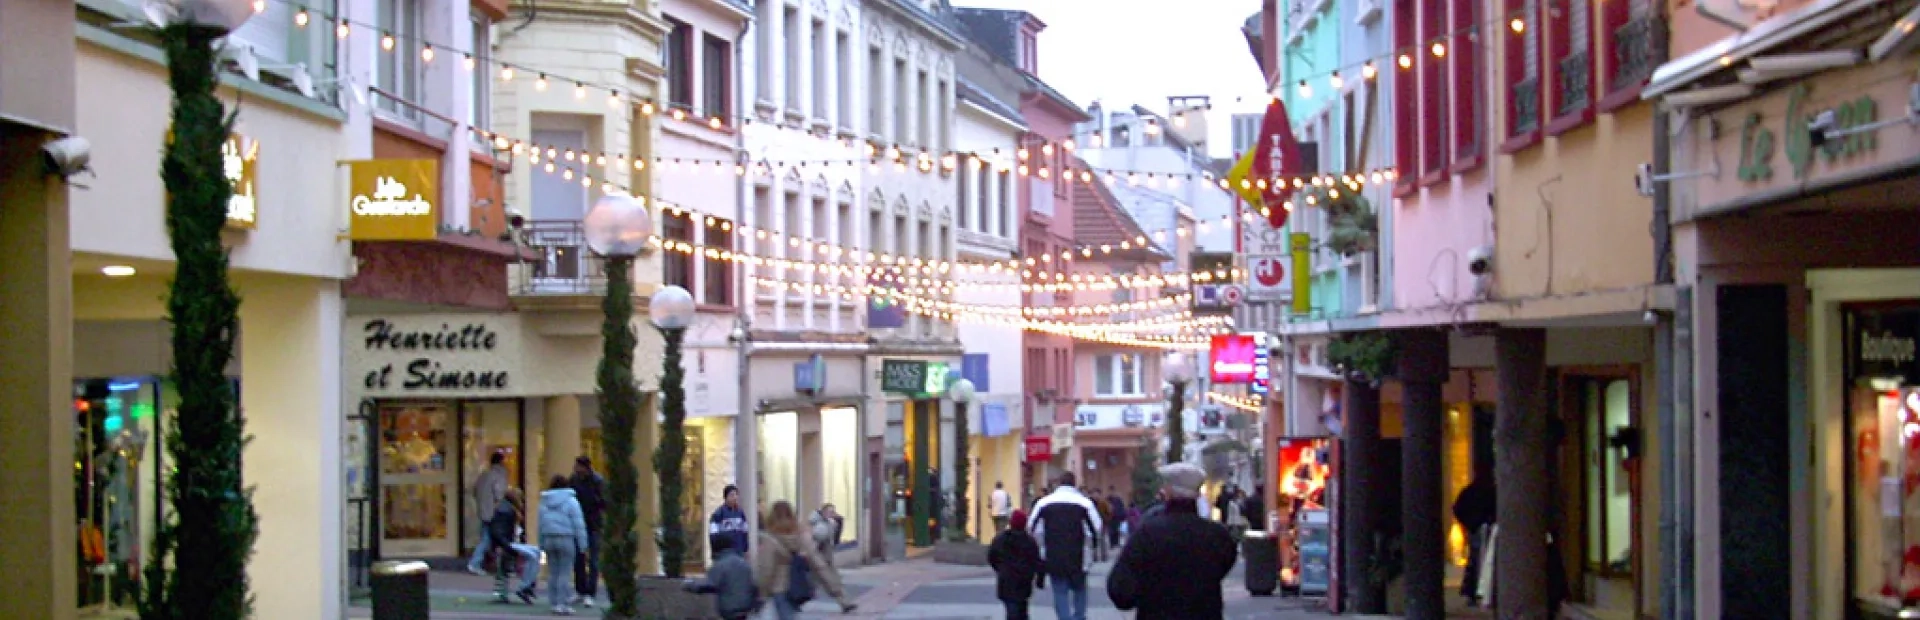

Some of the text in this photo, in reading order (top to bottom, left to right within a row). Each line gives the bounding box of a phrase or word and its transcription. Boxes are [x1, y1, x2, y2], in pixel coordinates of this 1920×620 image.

[1738, 110, 1775, 182] Le
[364, 318, 497, 350] Henriette
[364, 357, 508, 389] et Simone
